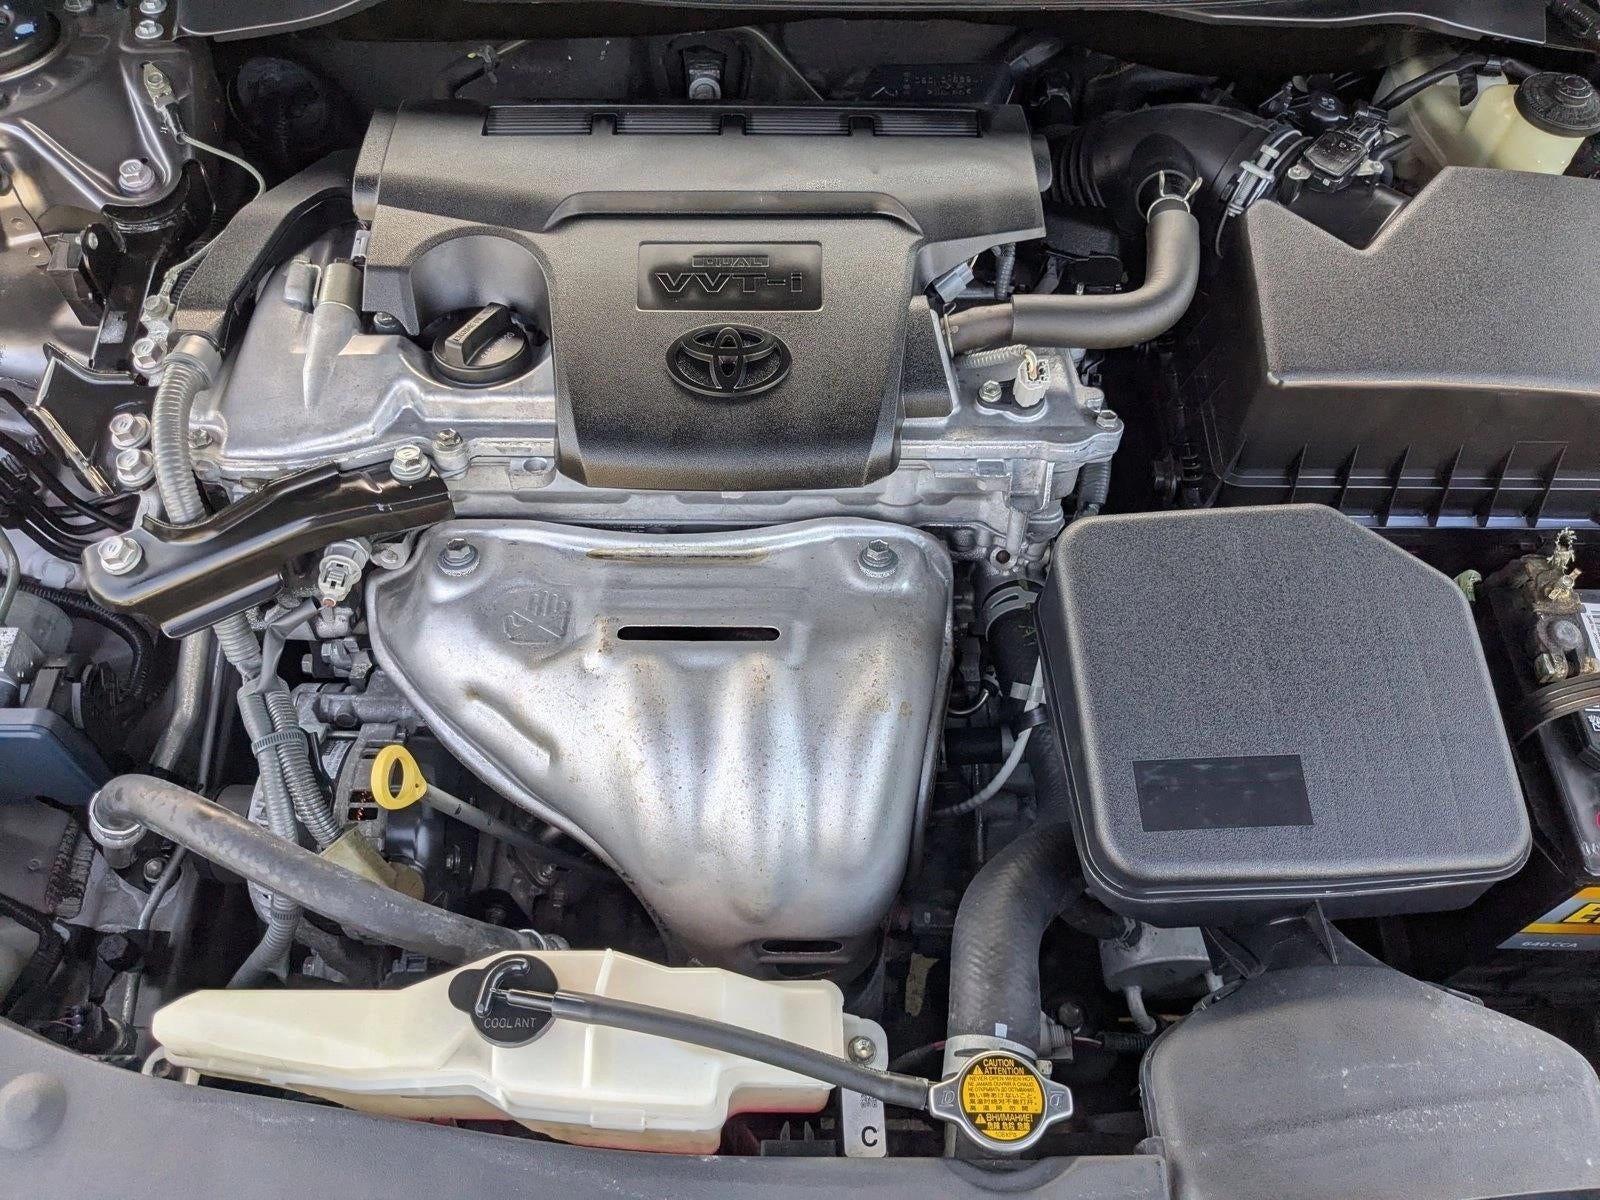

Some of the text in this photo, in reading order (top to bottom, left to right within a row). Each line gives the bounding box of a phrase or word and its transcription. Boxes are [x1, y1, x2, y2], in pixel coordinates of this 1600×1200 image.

[655, 272, 803, 293] VVT-i
[484, 1017, 537, 1029] COOLANT
[983, 1059, 1015, 1067] CAUTION
[984, 1067, 1025, 1075] ATTENTION
[986, 1113, 1034, 1122] ВНИМАНИЕ!
[861, 1125, 878, 1147] C
